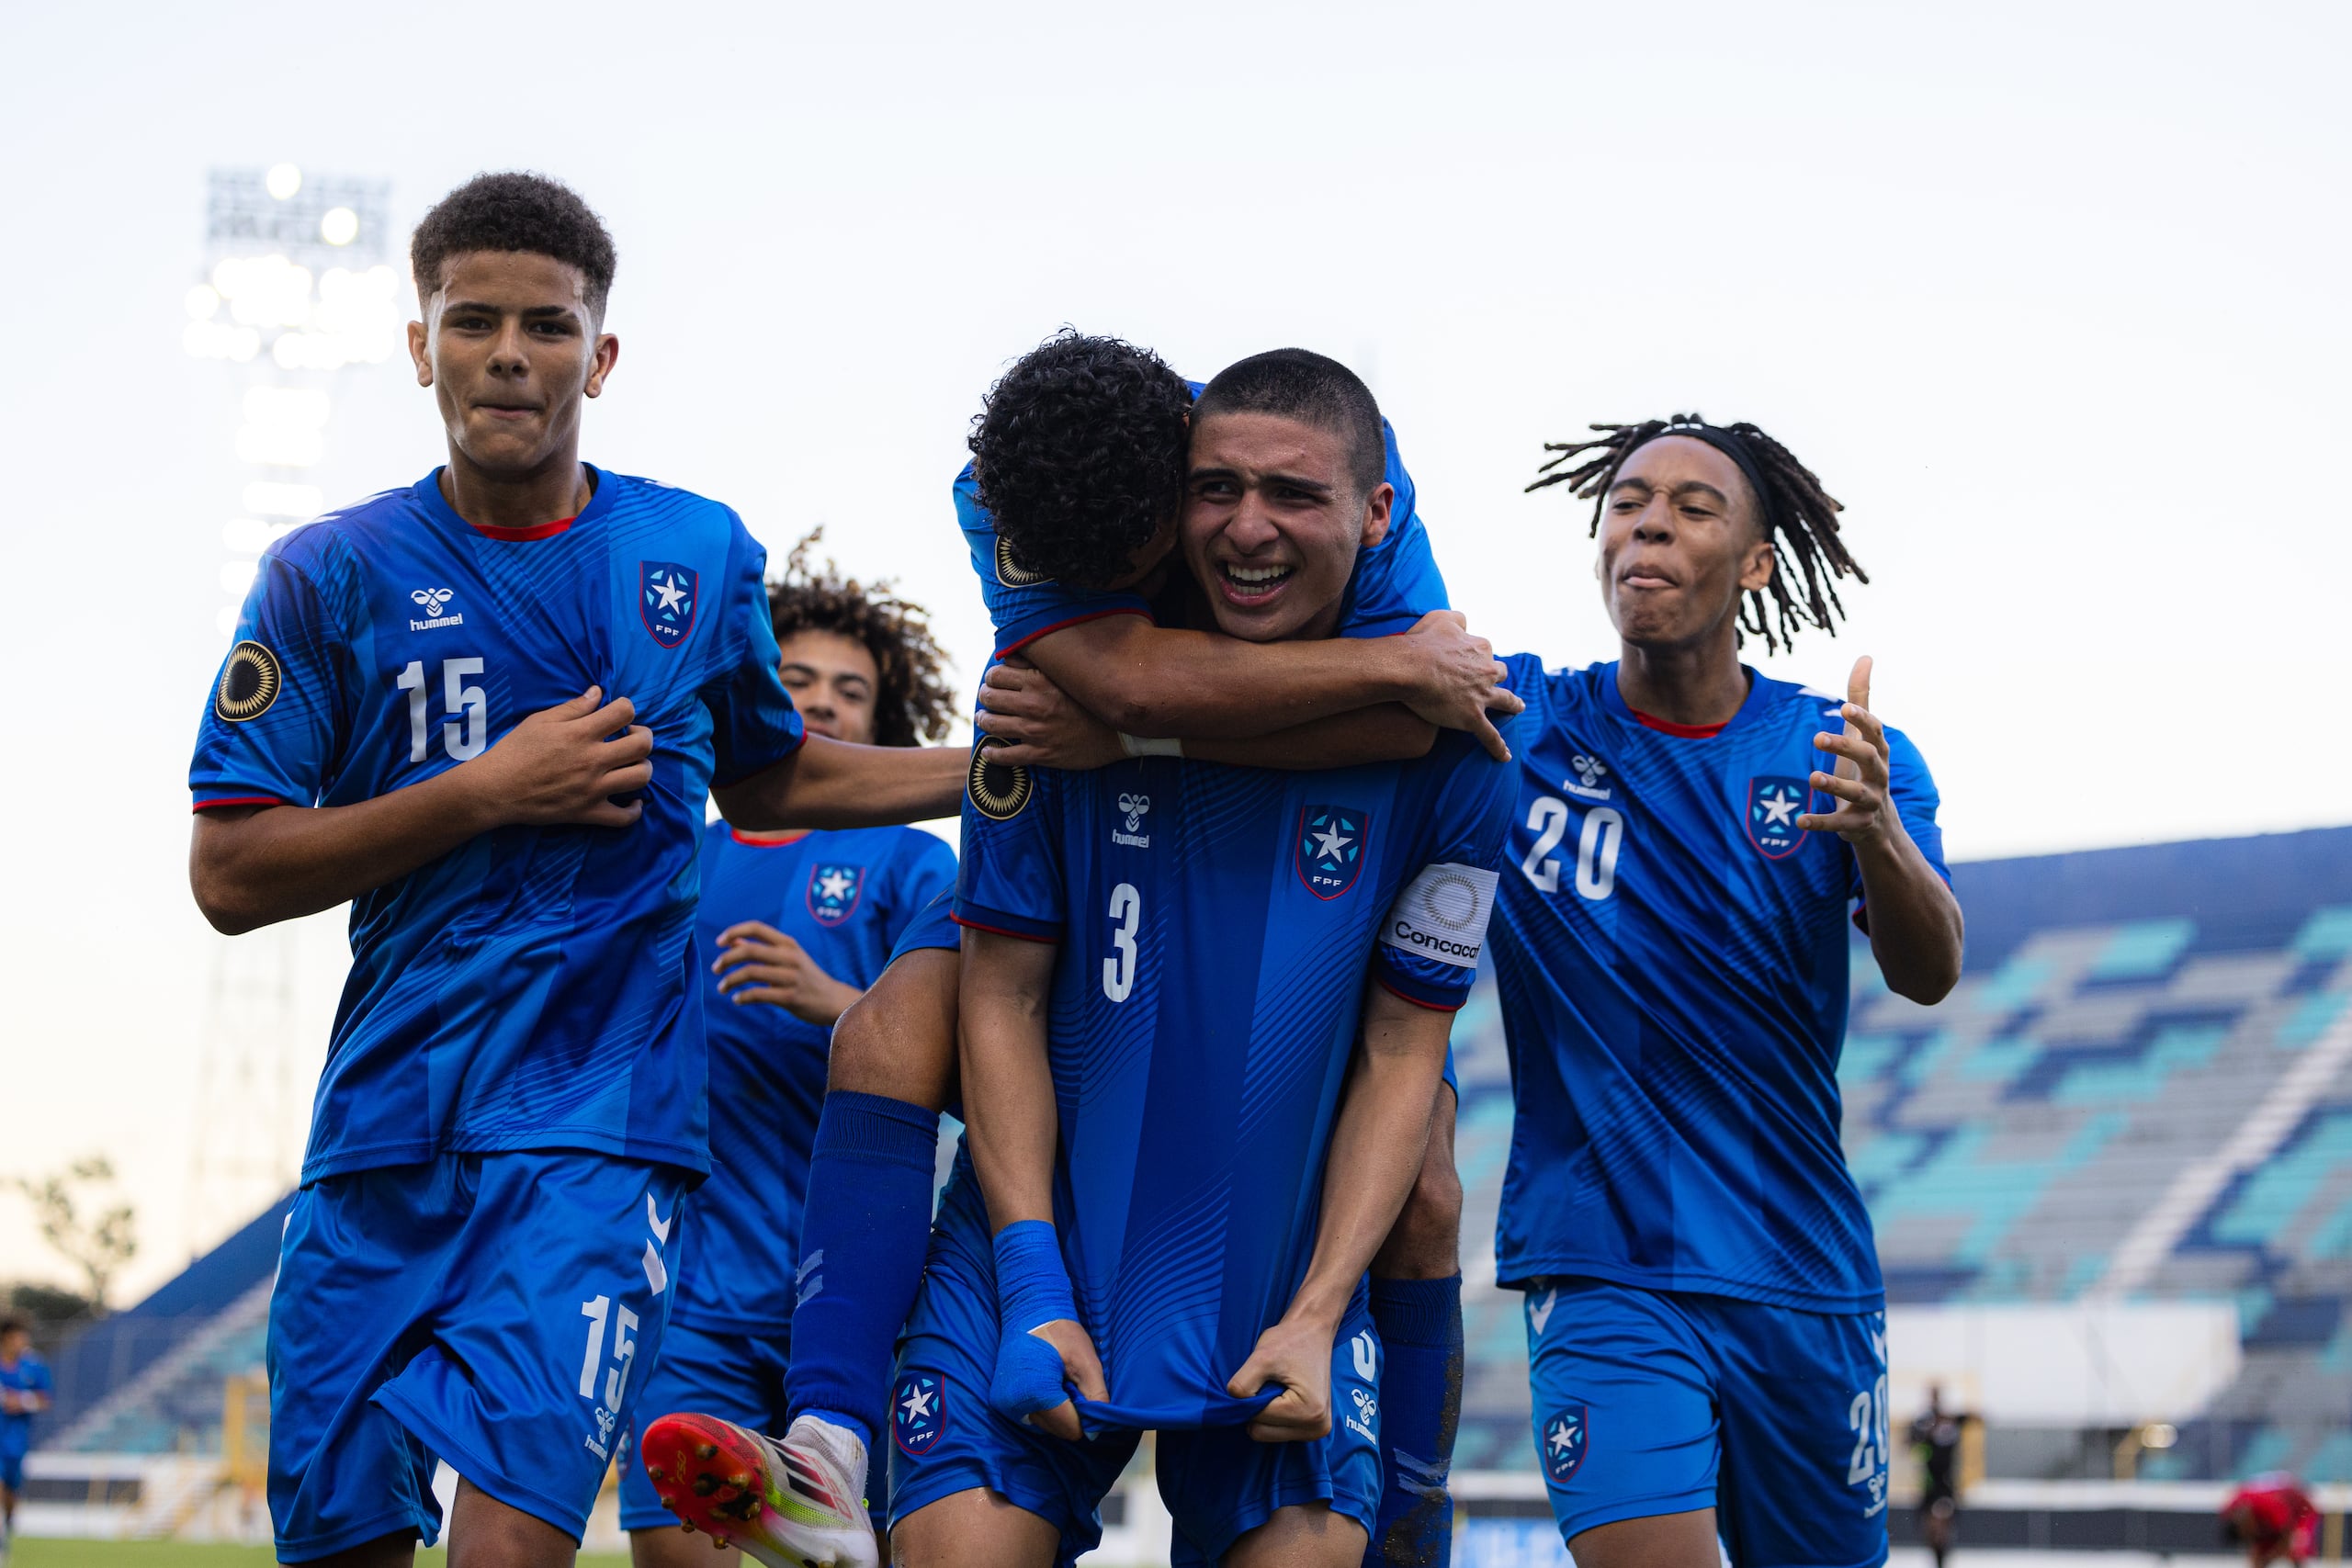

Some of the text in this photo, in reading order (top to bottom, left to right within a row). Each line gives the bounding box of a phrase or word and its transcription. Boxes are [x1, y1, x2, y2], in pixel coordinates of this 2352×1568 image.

[410, 613, 463, 631] hummel
[655, 624, 679, 637] FPF
[397, 657, 487, 762] 15
[1112, 829, 1149, 849] hummel
[1521, 795, 1623, 901] 20
[1312, 875, 1342, 887] FPF
[1102, 883, 1141, 1003] 3
[579, 1294, 639, 1415] 15
[909, 1430, 934, 1445] FPF
[1848, 1373, 1888, 1485] 20
